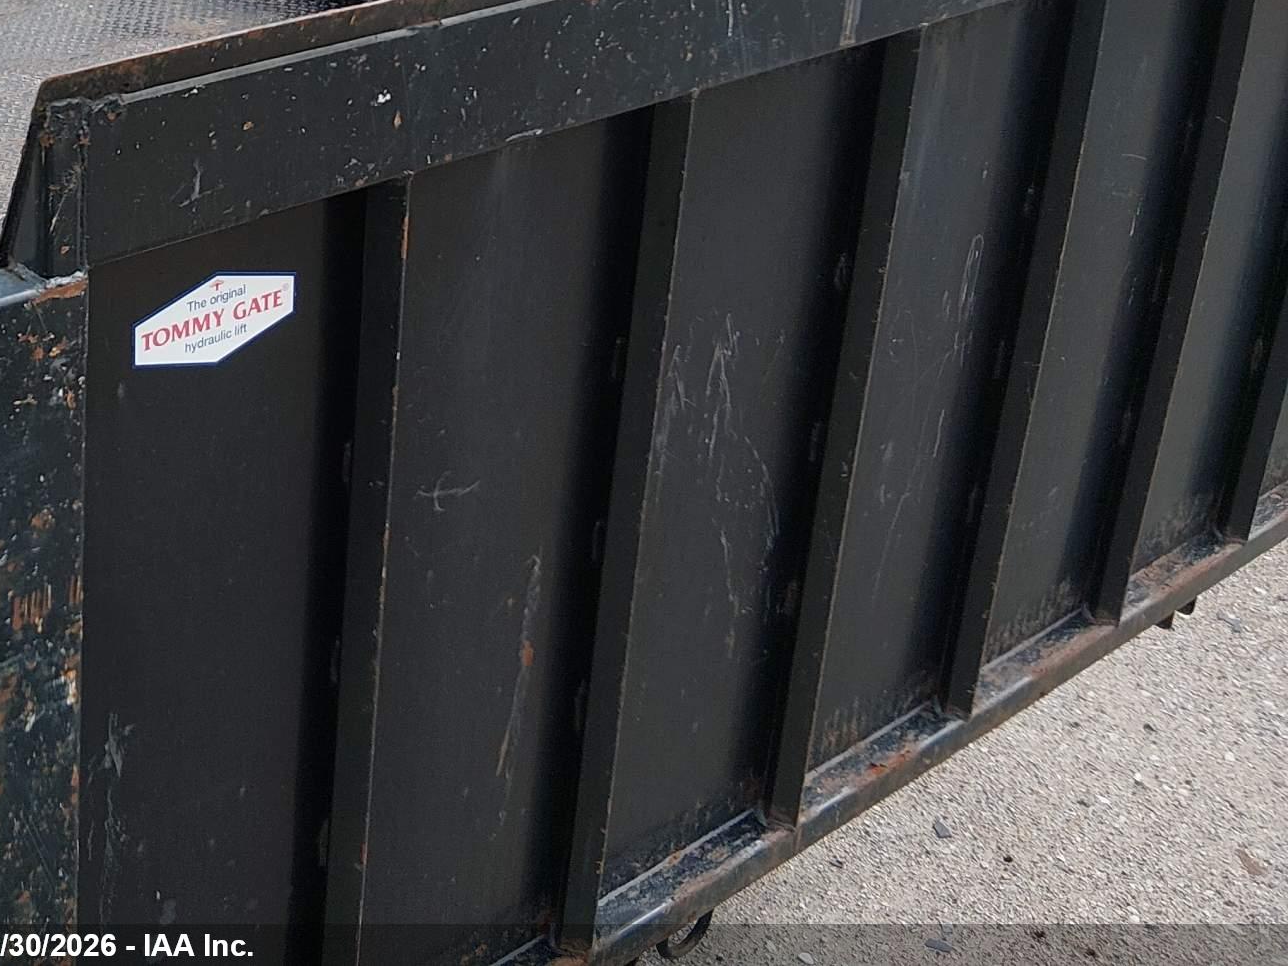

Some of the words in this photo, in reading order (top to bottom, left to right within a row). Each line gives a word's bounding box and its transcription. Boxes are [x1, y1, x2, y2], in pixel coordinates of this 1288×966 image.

[187, 299, 208, 313] The
[210, 284, 247, 304] original
[141, 308, 224, 351] TOMMY
[233, 290, 284, 320] GATE
[184, 329, 232, 353] hydraulic
[234, 323, 248, 336] lift
